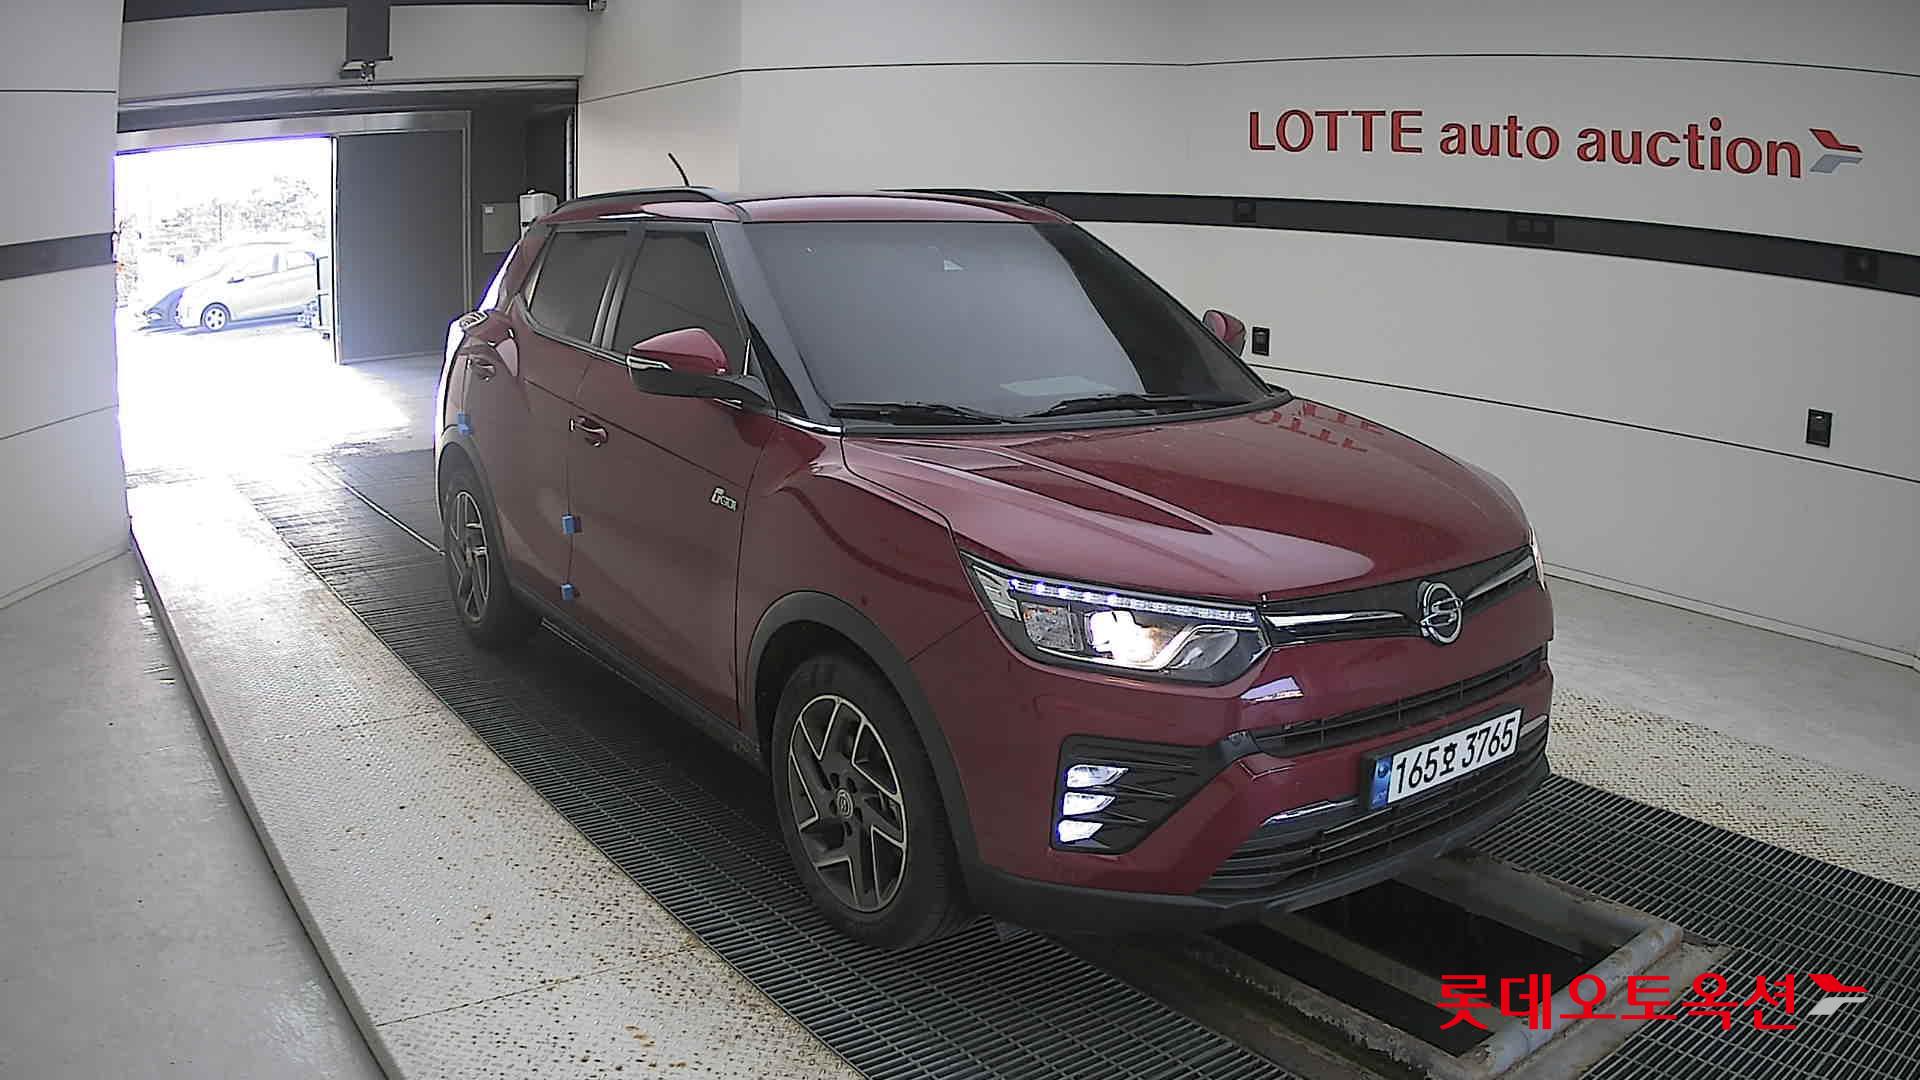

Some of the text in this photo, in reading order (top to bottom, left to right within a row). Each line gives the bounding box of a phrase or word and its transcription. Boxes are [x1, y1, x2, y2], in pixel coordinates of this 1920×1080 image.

[1249, 110, 1802, 179] LOTTE auto auction
[1395, 717, 1516, 794] 165호 3765
